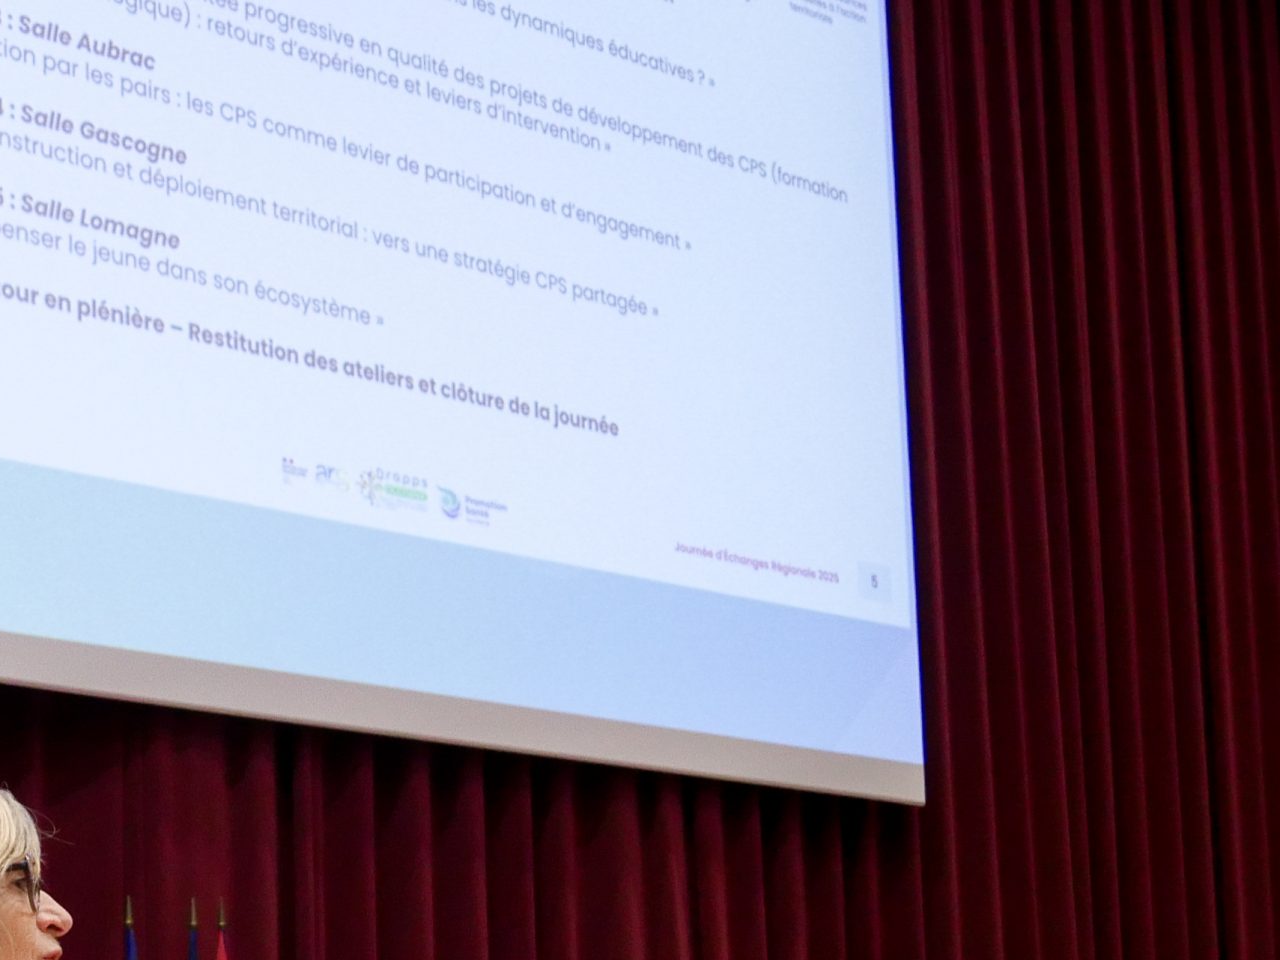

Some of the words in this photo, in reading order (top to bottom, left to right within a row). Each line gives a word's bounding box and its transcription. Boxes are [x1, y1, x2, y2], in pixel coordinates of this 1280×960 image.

[18, 15, 72, 46] Salle
[76, 33, 155, 70] Aubrac
[207, 17, 276, 51] retours
[280, 38, 399, 89] d'expérience
[403, 78, 421, 96] et
[426, 81, 482, 115] leviers
[486, 102, 600, 150] d'intervention
[472, 0, 496, 16] les
[500, 4, 604, 52] dynamiques
[608, 39, 694, 83] éducatives
[20, 104, 74, 134] Salle
[79, 121, 187, 165] Gascogne
[244, 1, 354, 49] progressive
[359, 37, 382, 57] en
[387, 47, 449, 78] qualité
[453, 65, 485, 90] des
[489, 79, 548, 110] projets
[551, 97, 573, 117] de
[577, 105, 703, 158] développement
[706, 146, 734, 168] des
[738, 155, 767, 178] CPS
[771, 161, 848, 203] (formation
[42, 54, 79, 77] par
[85, 62, 114, 88] les
[120, 76, 171, 104] pairs
[186, 91, 214, 117] les
[219, 102, 257, 129] CPS
[262, 117, 338, 152] comme
[342, 136, 391, 166] levier
[396, 154, 420, 175] de
[424, 164, 536, 208] participation
[540, 197, 557, 214] et
[560, 201, 680, 250] d'engagement
[21, 194, 74, 223] Salle
[79, 208, 180, 249] Lomagne
[112, 161, 133, 181] et
[138, 165, 266, 216] déploiement
[272, 200, 358, 239] territorial
[372, 231, 410, 253] vers
[414, 242, 449, 264] une
[453, 251, 531, 285] stratégie
[534, 270, 567, 295] CPS
[571, 283, 648, 316] partagée
[68, 233, 86, 257] le
[91, 239, 151, 272] jeune
[156, 257, 207, 286] dans
[213, 273, 248, 296] son
[254, 280, 371, 326] écosystème
[44, 293, 71, 313] en
[76, 298, 165, 334] plénière
[188, 322, 299, 364] Restitution
[303, 349, 338, 373] des
[342, 361, 414, 390] ateliers
[417, 378, 436, 396] et
[440, 382, 504, 411] clôture
[508, 396, 530, 417] de
[534, 400, 550, 421] la
[553, 404, 619, 437] journée
[674, 542, 714, 559] Journée
[714, 549, 769, 571] d'Échanges
[770, 560, 816, 579] Régionale
[818, 569, 840, 583] 2025
